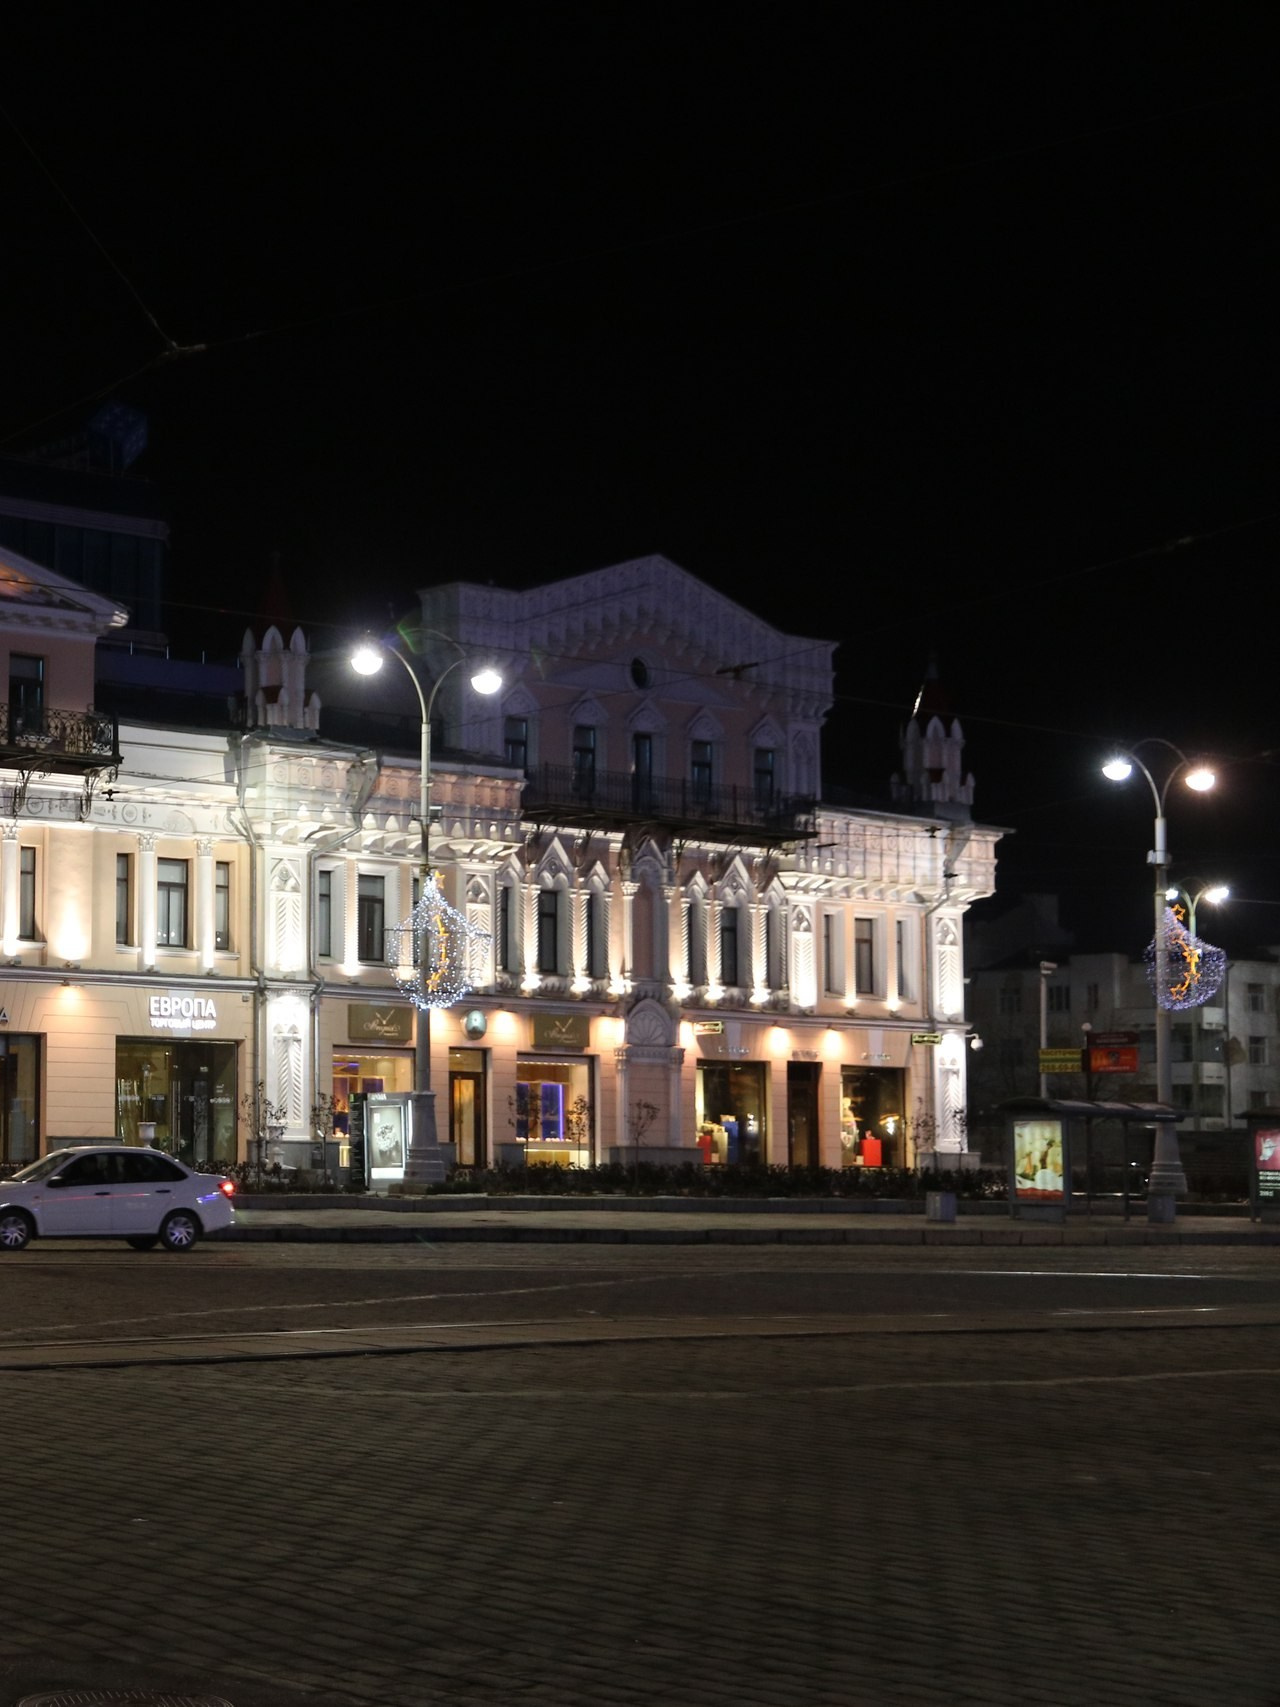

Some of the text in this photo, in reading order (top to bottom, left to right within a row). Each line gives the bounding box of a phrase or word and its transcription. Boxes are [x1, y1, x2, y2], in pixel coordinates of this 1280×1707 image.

[150, 996, 217, 1018] ЕВРОПА
[150, 1018, 217, 1031] ТОРГОВЫЙ ЦЕНТР
